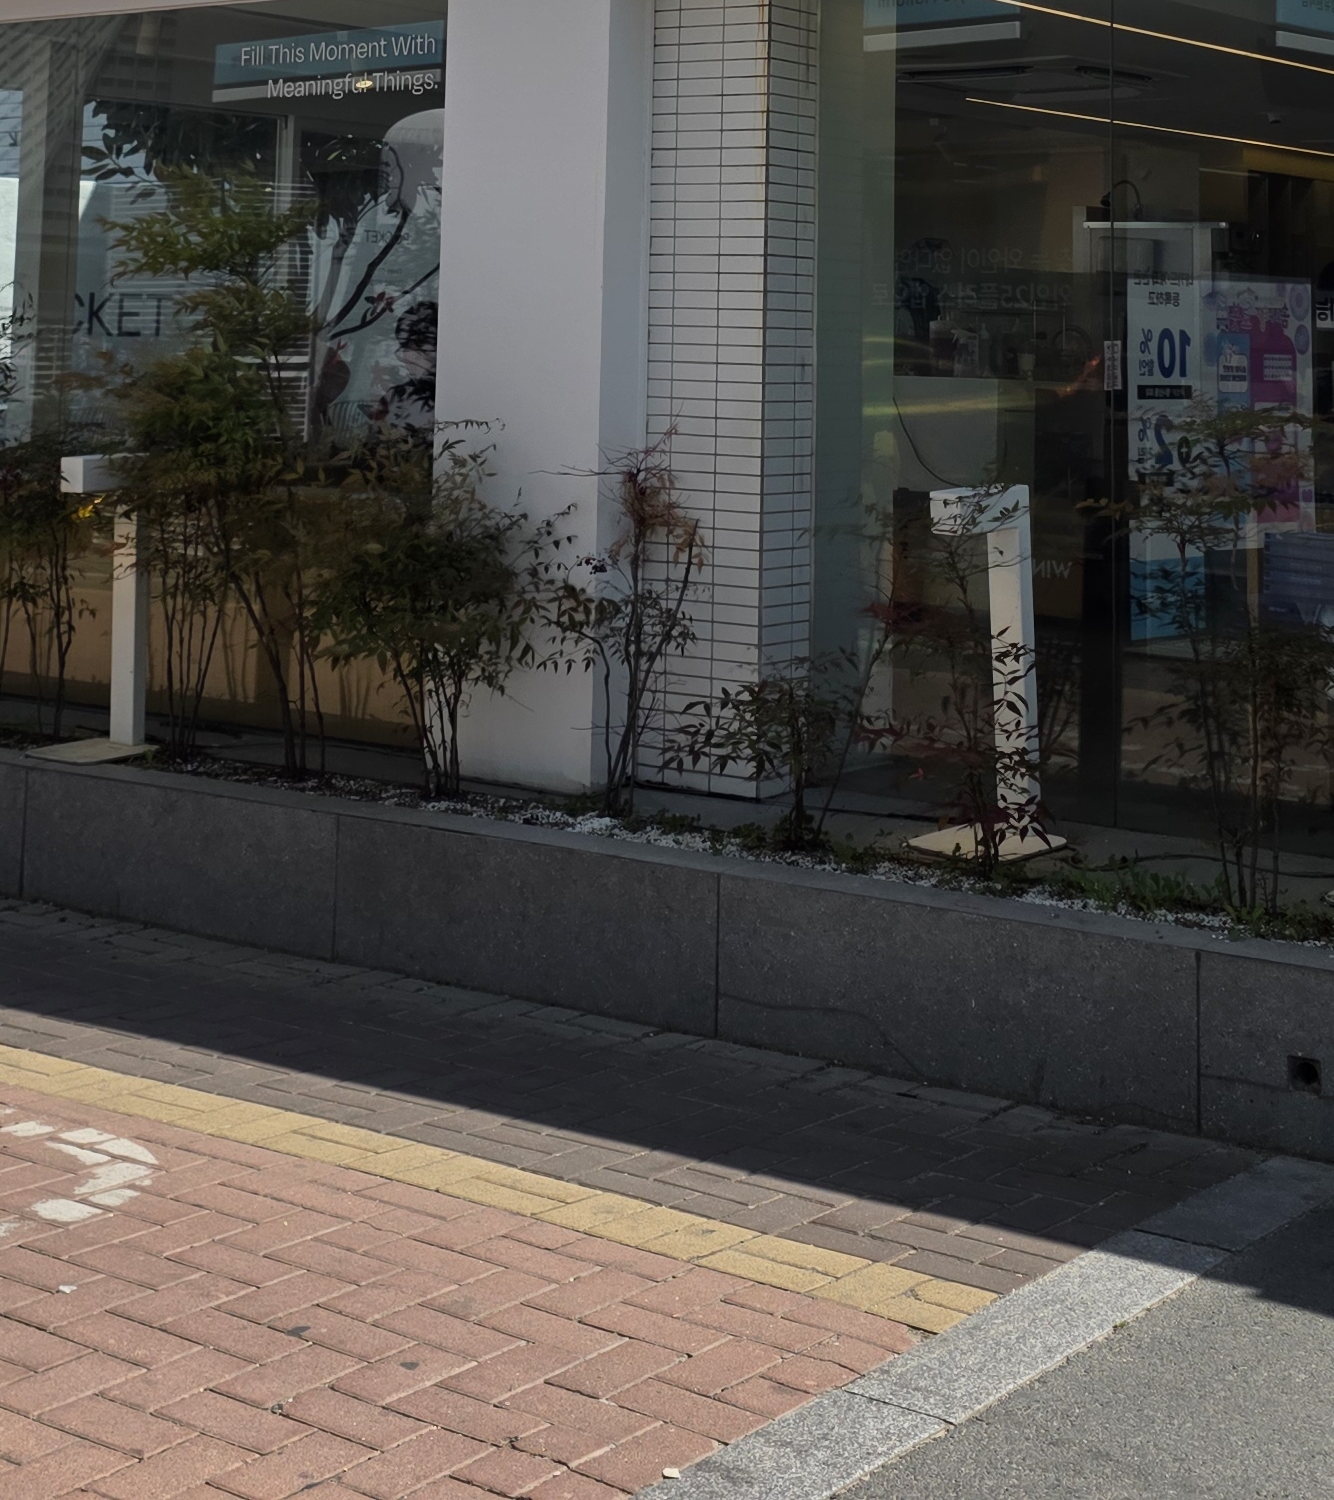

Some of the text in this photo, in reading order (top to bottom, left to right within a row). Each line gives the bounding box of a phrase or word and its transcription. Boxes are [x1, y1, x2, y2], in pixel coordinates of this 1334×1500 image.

[240, 32, 437, 67] Fill This Moment With
[266, 70, 439, 100] Meaningful Things.
